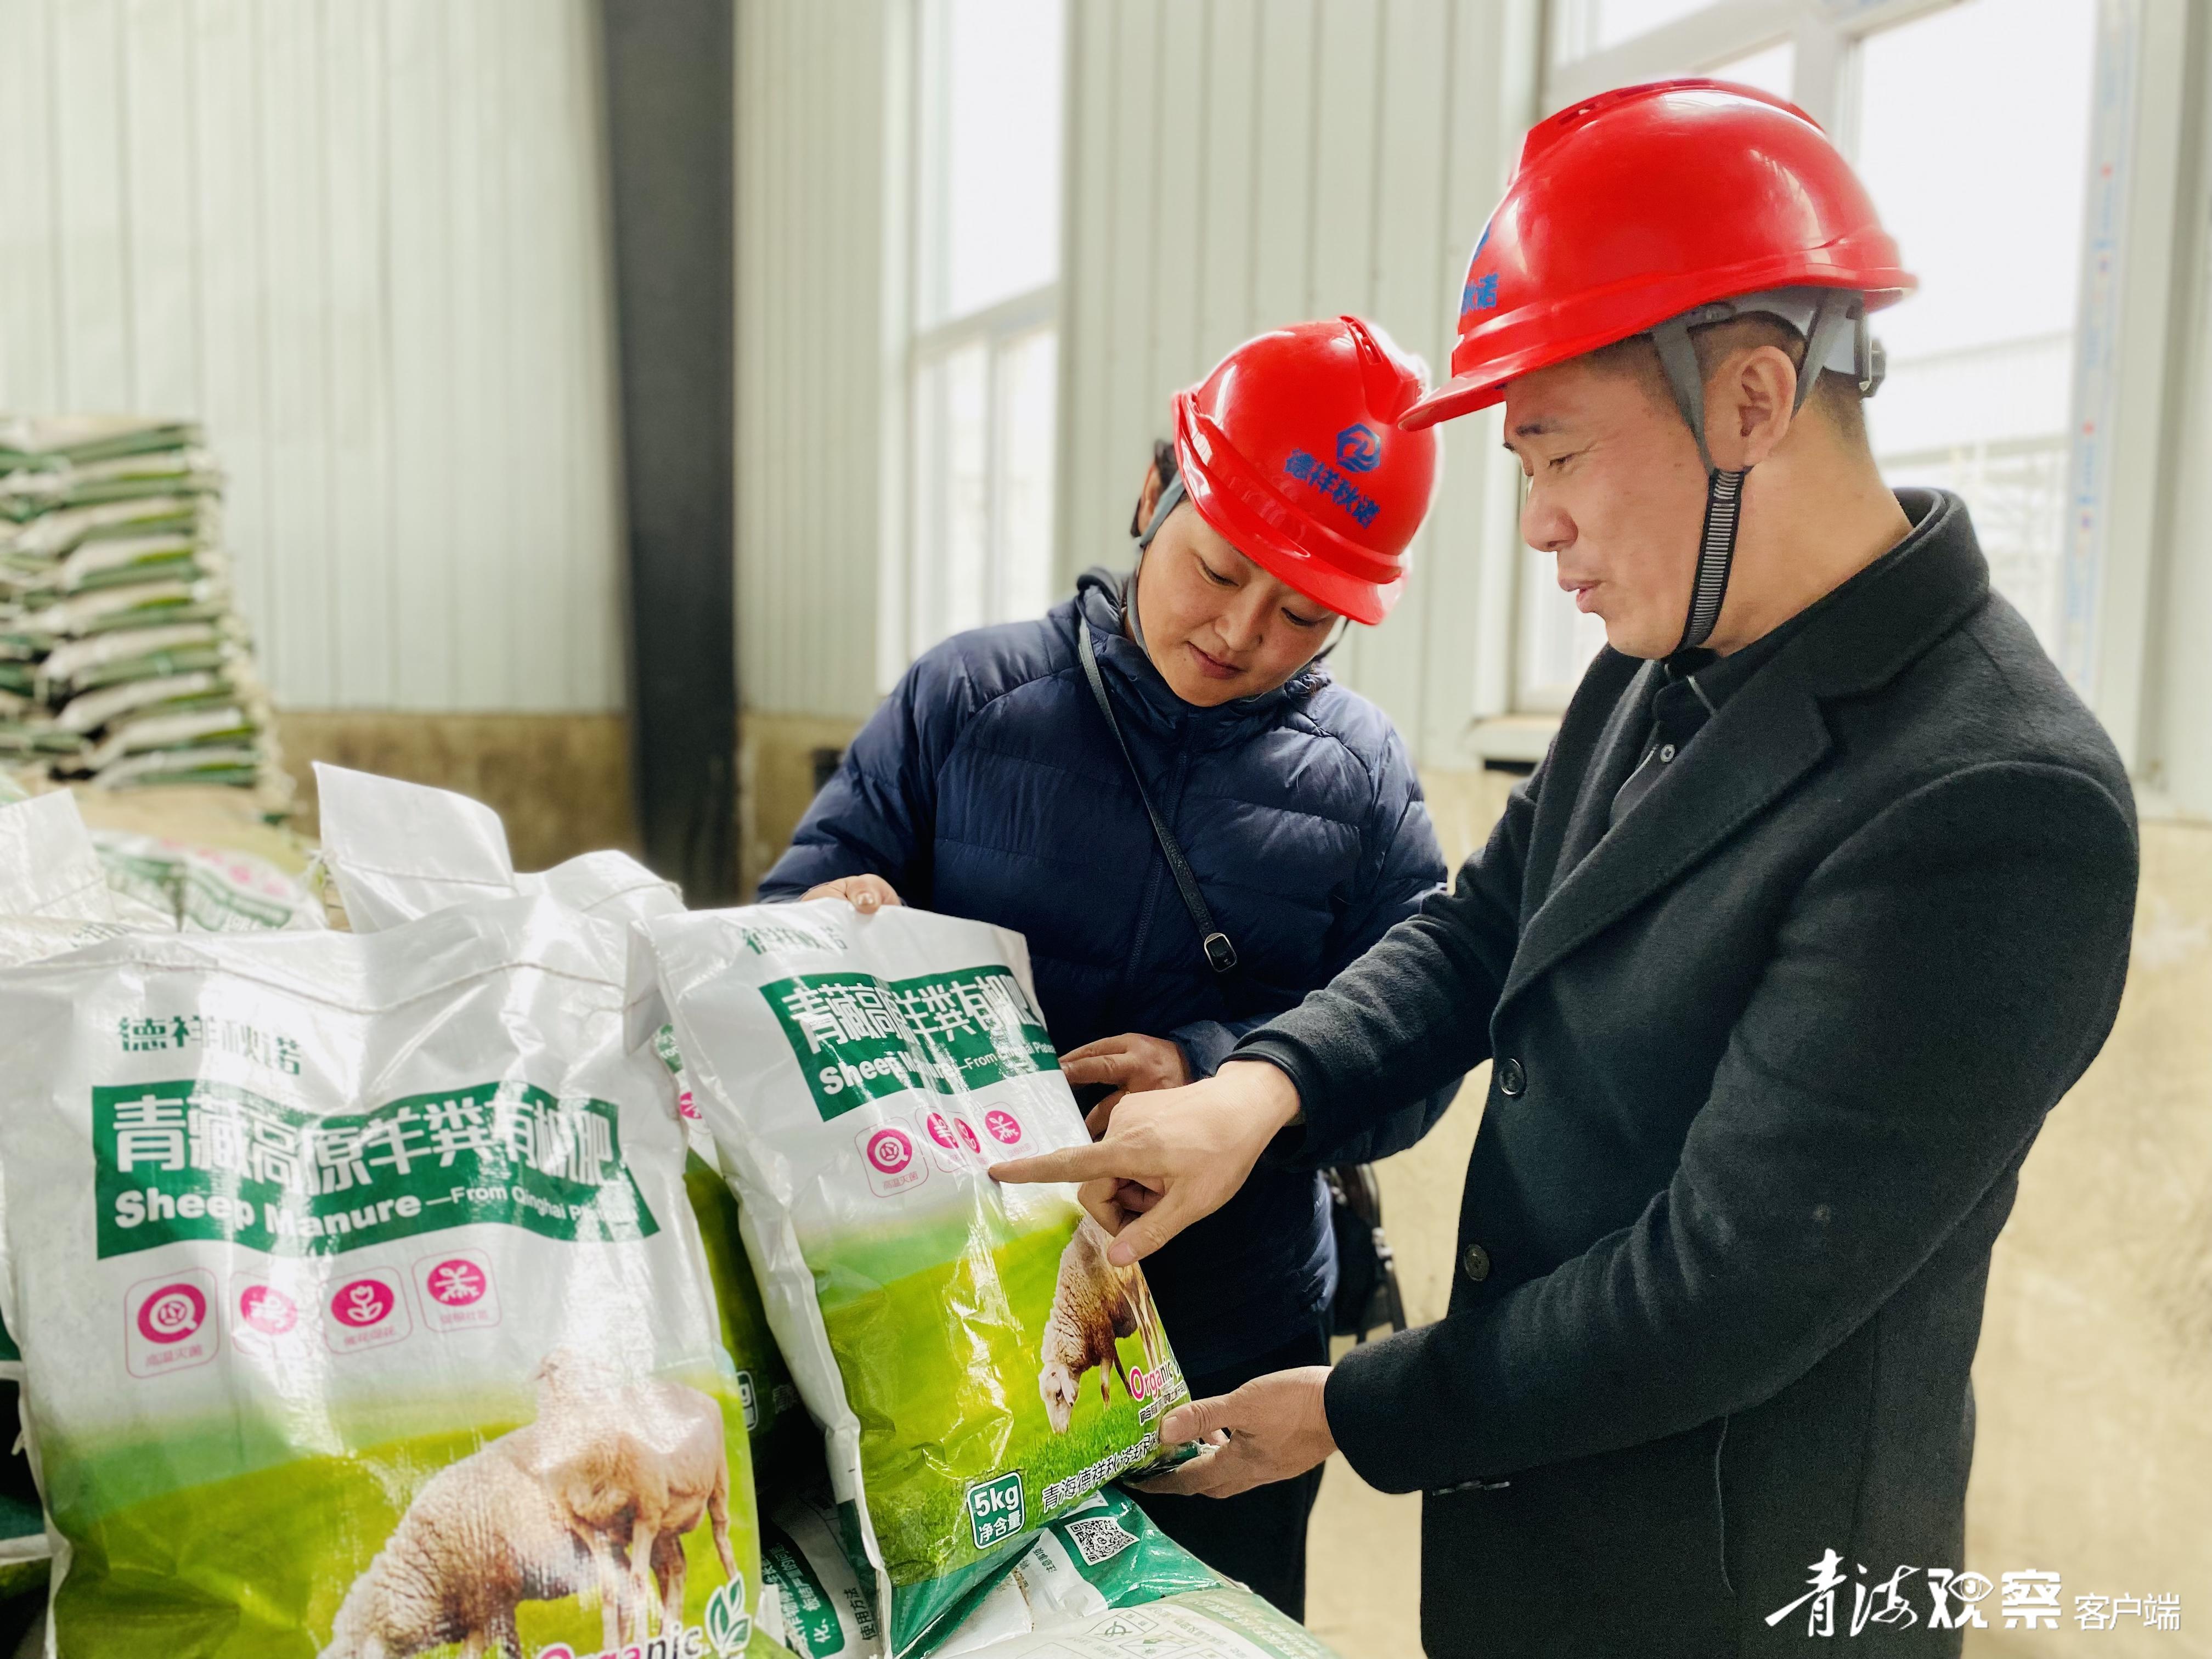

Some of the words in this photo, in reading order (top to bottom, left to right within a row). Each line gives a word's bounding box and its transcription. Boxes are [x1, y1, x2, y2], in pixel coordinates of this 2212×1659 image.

[114, 1187, 256, 1231] Sheep
[264, 1194, 422, 1238] Manure
[511, 1186, 567, 1220] Qinghai
[1130, 1357, 1173, 1400] Organic
[974, 1485, 1019, 1517] 5kg
[978, 1509, 1022, 1544] 净含量
[844, 1587, 877, 1640] 使用方法
